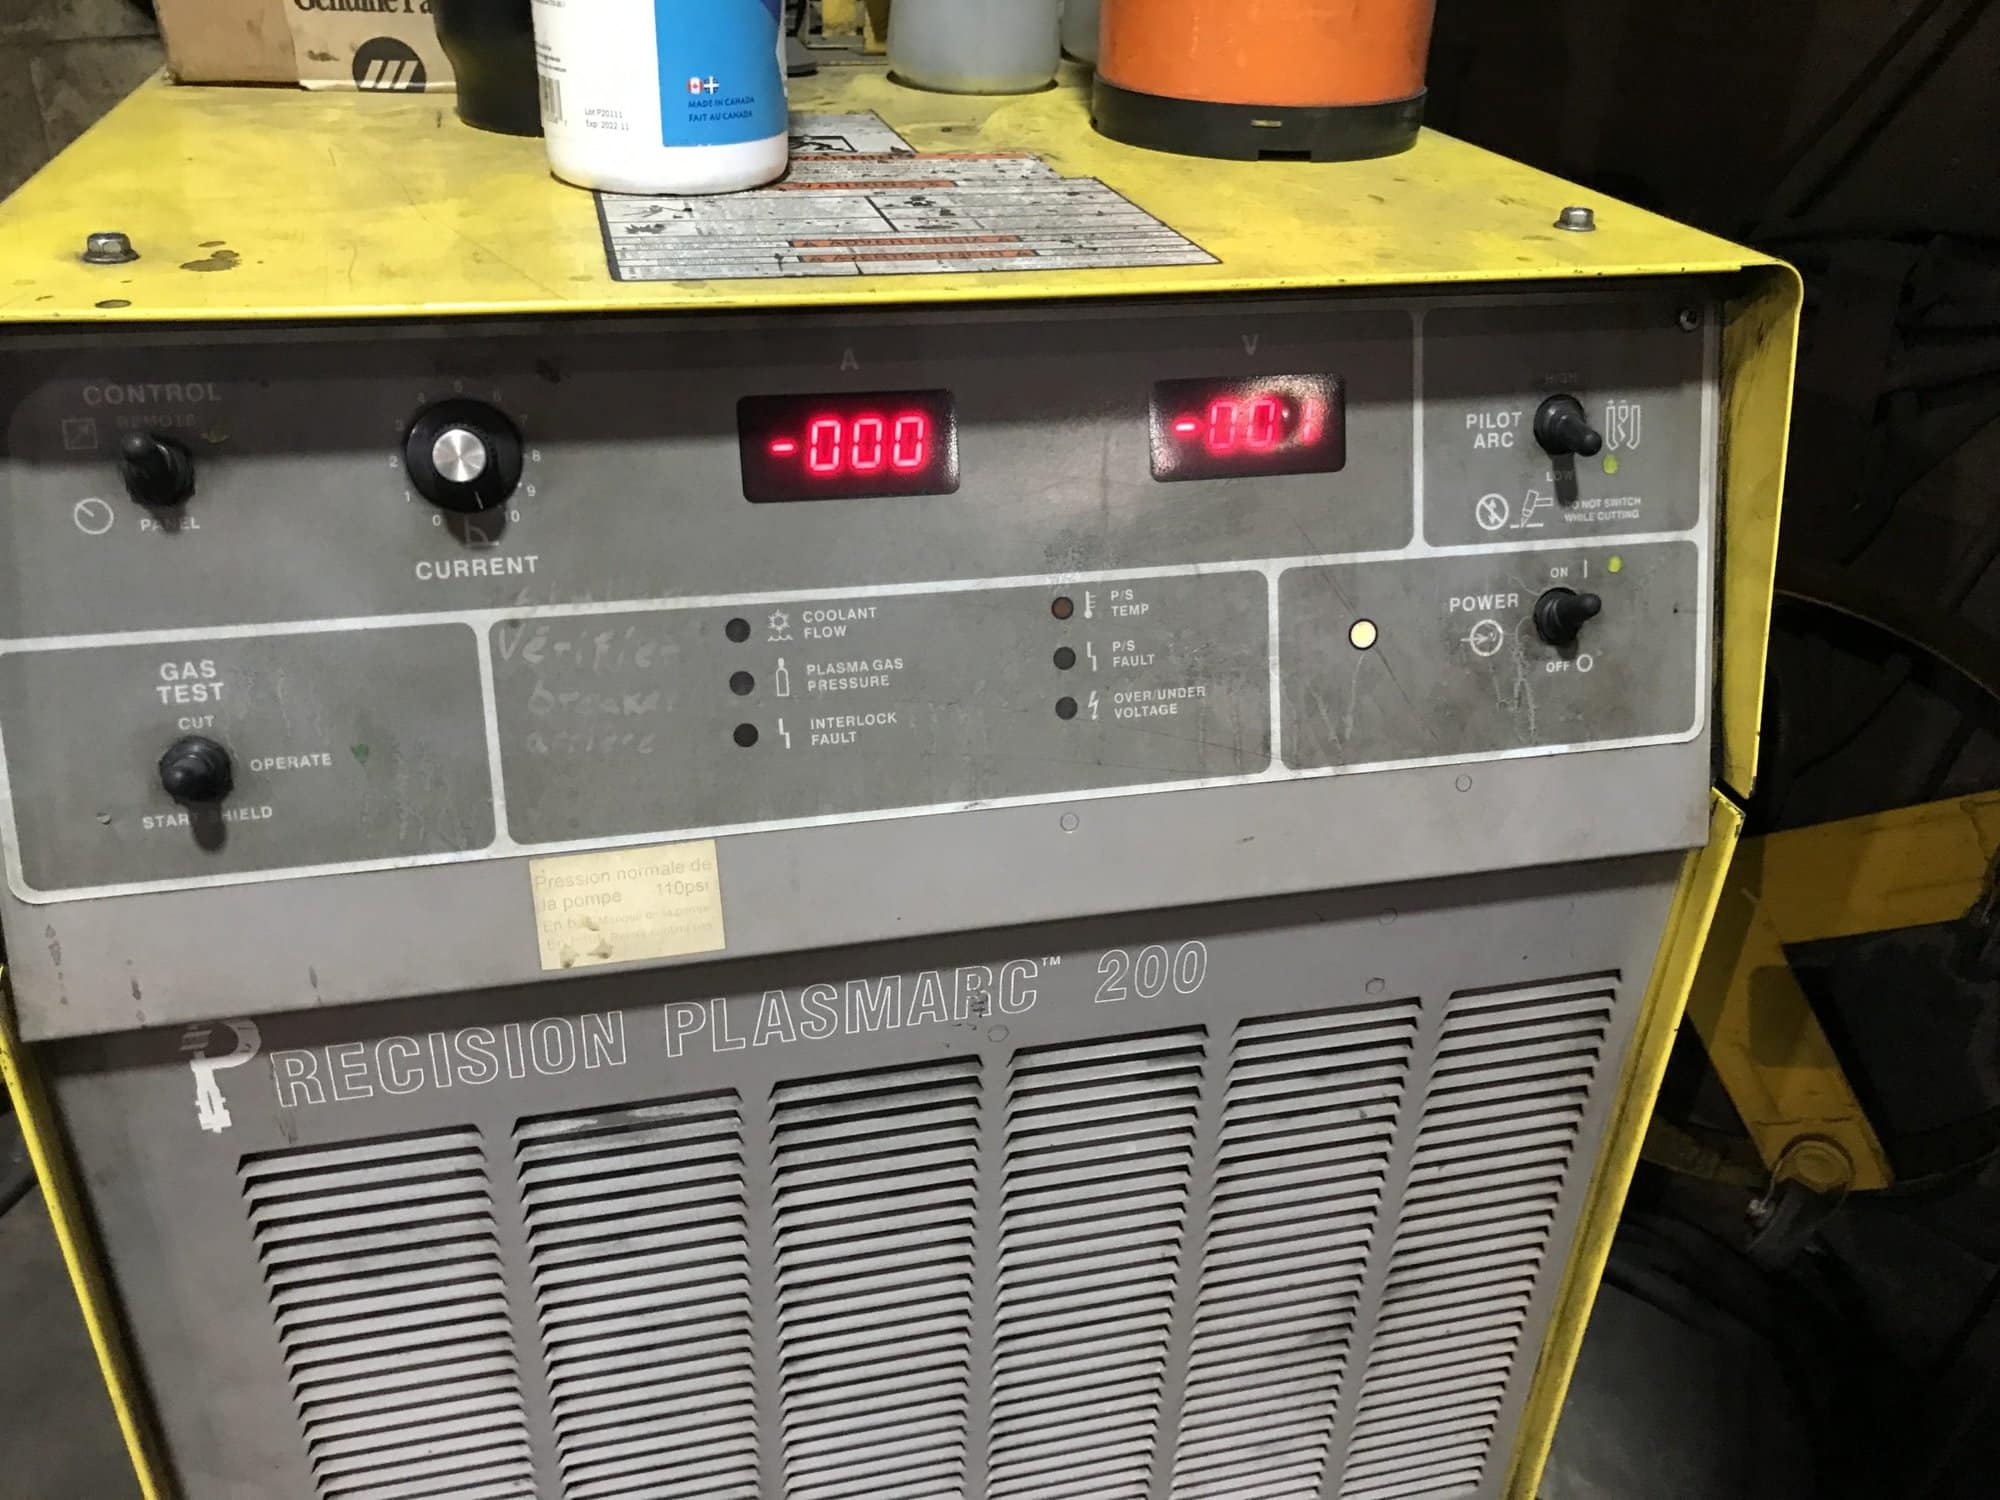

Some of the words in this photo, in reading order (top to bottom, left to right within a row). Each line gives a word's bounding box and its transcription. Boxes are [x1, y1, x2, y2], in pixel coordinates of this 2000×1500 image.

[688, 99, 713, 108] MADE
[714, 98, 723, 107] IN
[724, 96, 755, 106] CANADA
[688, 113, 708, 123] FAIT
[708, 112, 721, 121] AU
[722, 110, 753, 121] CANADA
[1241, 334, 1259, 356] V
[841, 349, 859, 372] A
[82, 382, 222, 406] CONTROL
[1466, 411, 1522, 430] PILOT
[1473, 432, 1515, 449] ARC
[1603, 496, 1642, 508] SWITCH
[1597, 509, 1640, 520] CUTTING
[415, 555, 539, 581] CURRENT
[1550, 566, 1568, 578] ON
[1110, 589, 1134, 601] P/S
[1450, 593, 1519, 612] POWER
[802, 606, 878, 624] COOLANT
[1111, 603, 1150, 617] TEMP
[804, 625, 847, 640] FLOW
[1112, 640, 1136, 652] P/S
[807, 660, 871, 676] PLASMA
[873, 657, 904, 671] GAS
[1112, 653, 1155, 668] FAULT
[1546, 661, 1571, 673] OFF
[160, 659, 217, 682] GAS
[807, 675, 890, 692] PRESSURE
[156, 682, 225, 705] TEST
[1114, 686, 1206, 704] OVER/UNDER
[1114, 704, 1178, 720] VOLTAGE
[177, 715, 215, 731] CUT
[810, 713, 898, 729] INTERLOCK
[811, 731, 857, 746] FAULT
[250, 752, 332, 772] OPERATE
[142, 809, 200, 830] STAR
[209, 805, 273, 824] HIELD
[535, 869, 611, 890] Pression
[616, 860, 686, 882] normale
[690, 857, 713, 871] de
[563, 891, 622, 913] pompe
[1094, 940, 1208, 1004] 200
